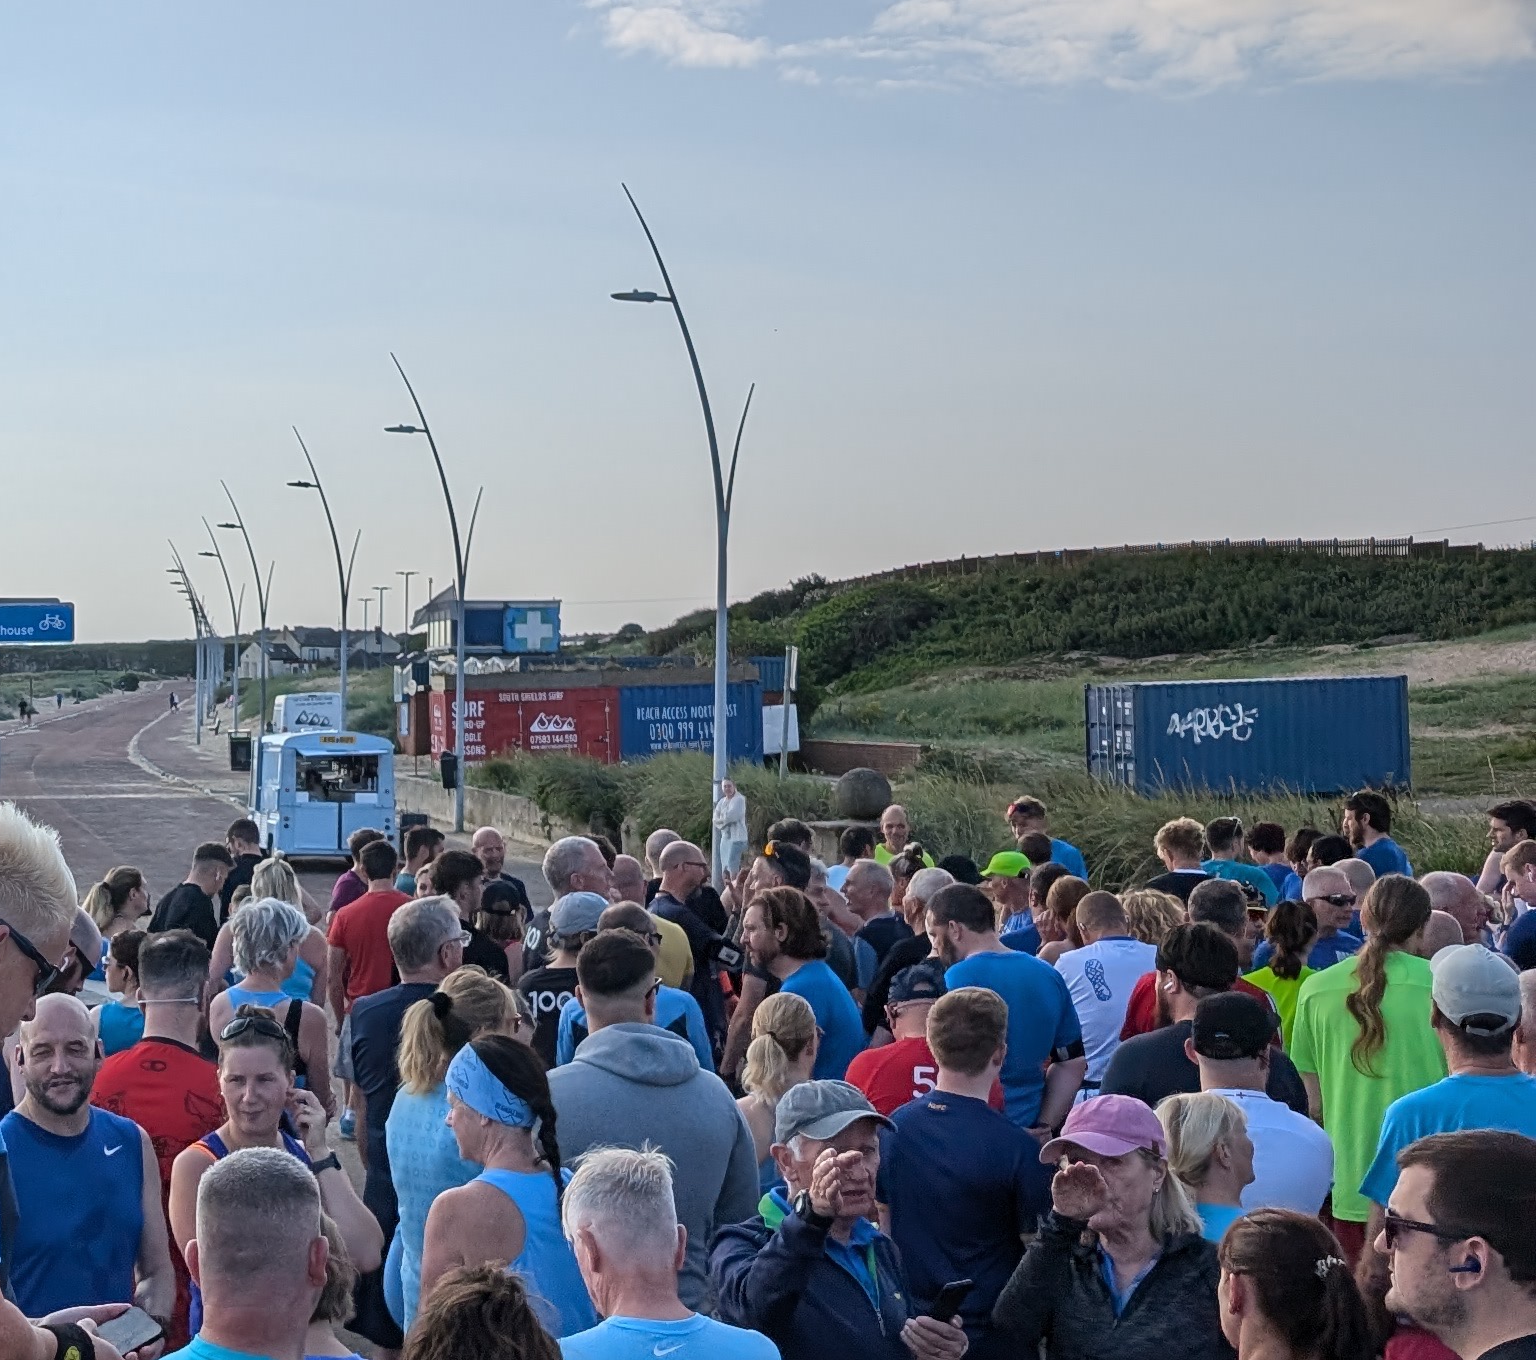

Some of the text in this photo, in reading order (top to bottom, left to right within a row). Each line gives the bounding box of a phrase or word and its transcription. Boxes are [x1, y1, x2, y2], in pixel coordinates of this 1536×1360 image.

[662, 706, 688, 720] ACCESS
[690, 704, 715, 719] NORT
[913, 1066, 936, 1098] 5
